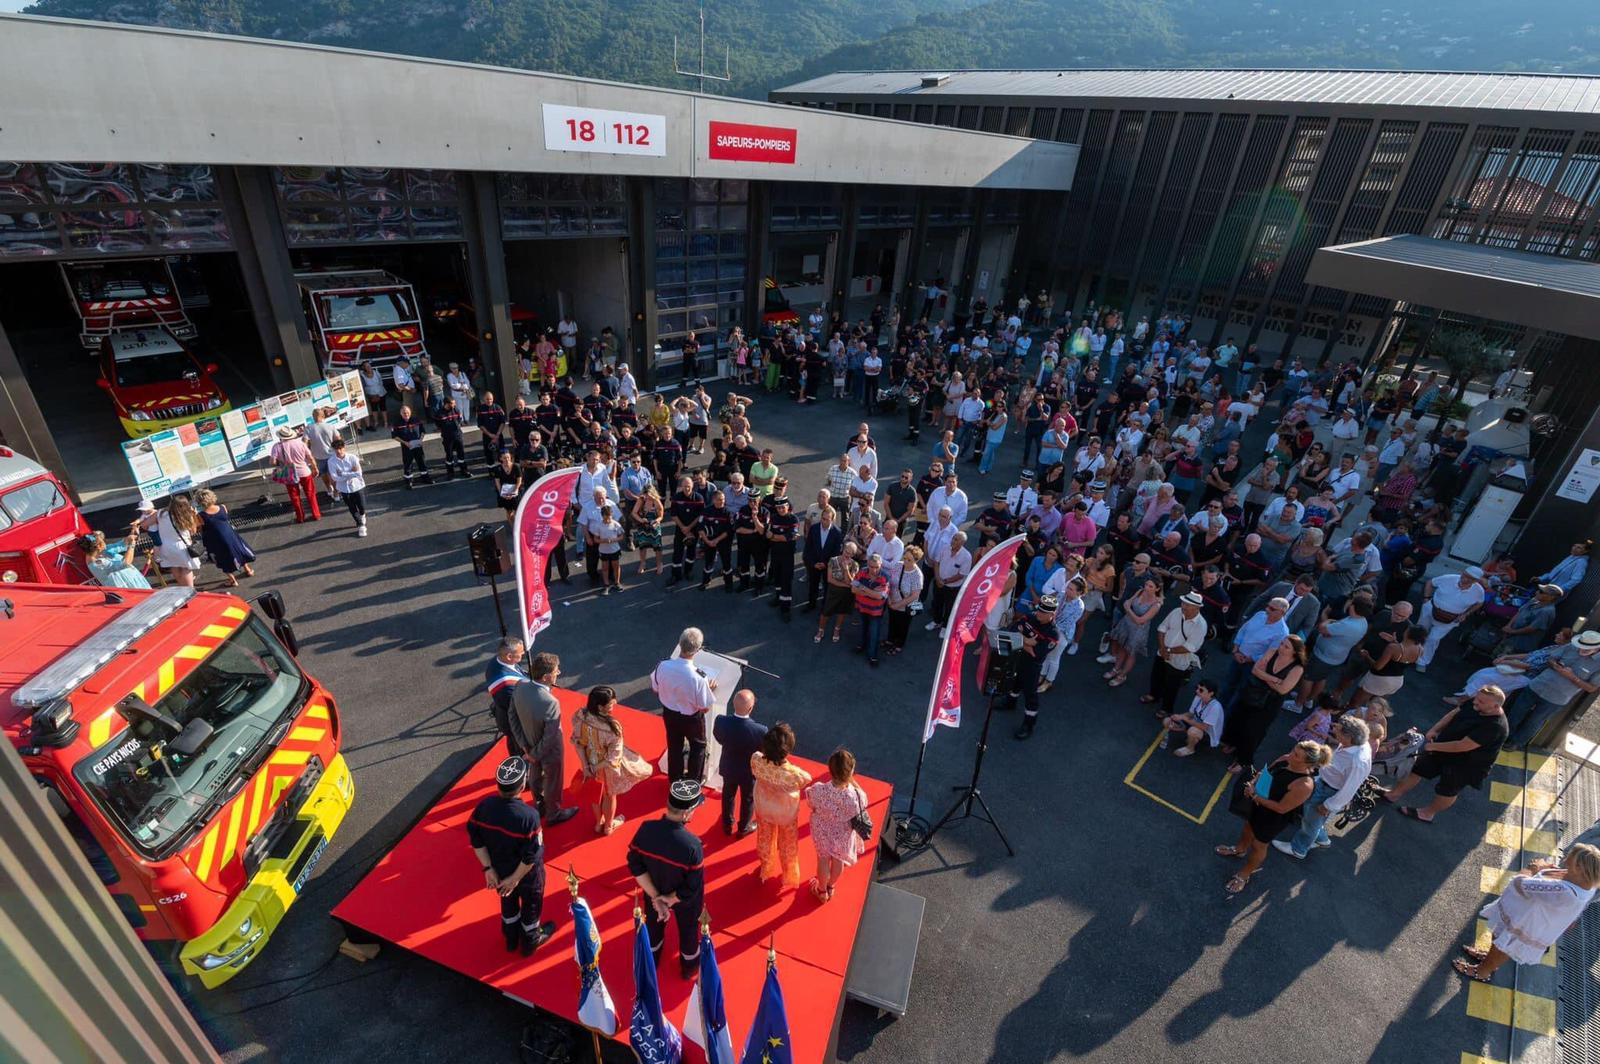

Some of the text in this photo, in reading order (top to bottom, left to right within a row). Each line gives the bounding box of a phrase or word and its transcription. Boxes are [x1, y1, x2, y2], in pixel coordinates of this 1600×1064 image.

[566, 119, 650, 145] 18 112
[717, 134, 791, 152] SAPEURS-POMPIERS
[538, 490, 559, 520] 06
[93, 763, 108, 776] CIE
[104, 750, 122, 768] PAYS
